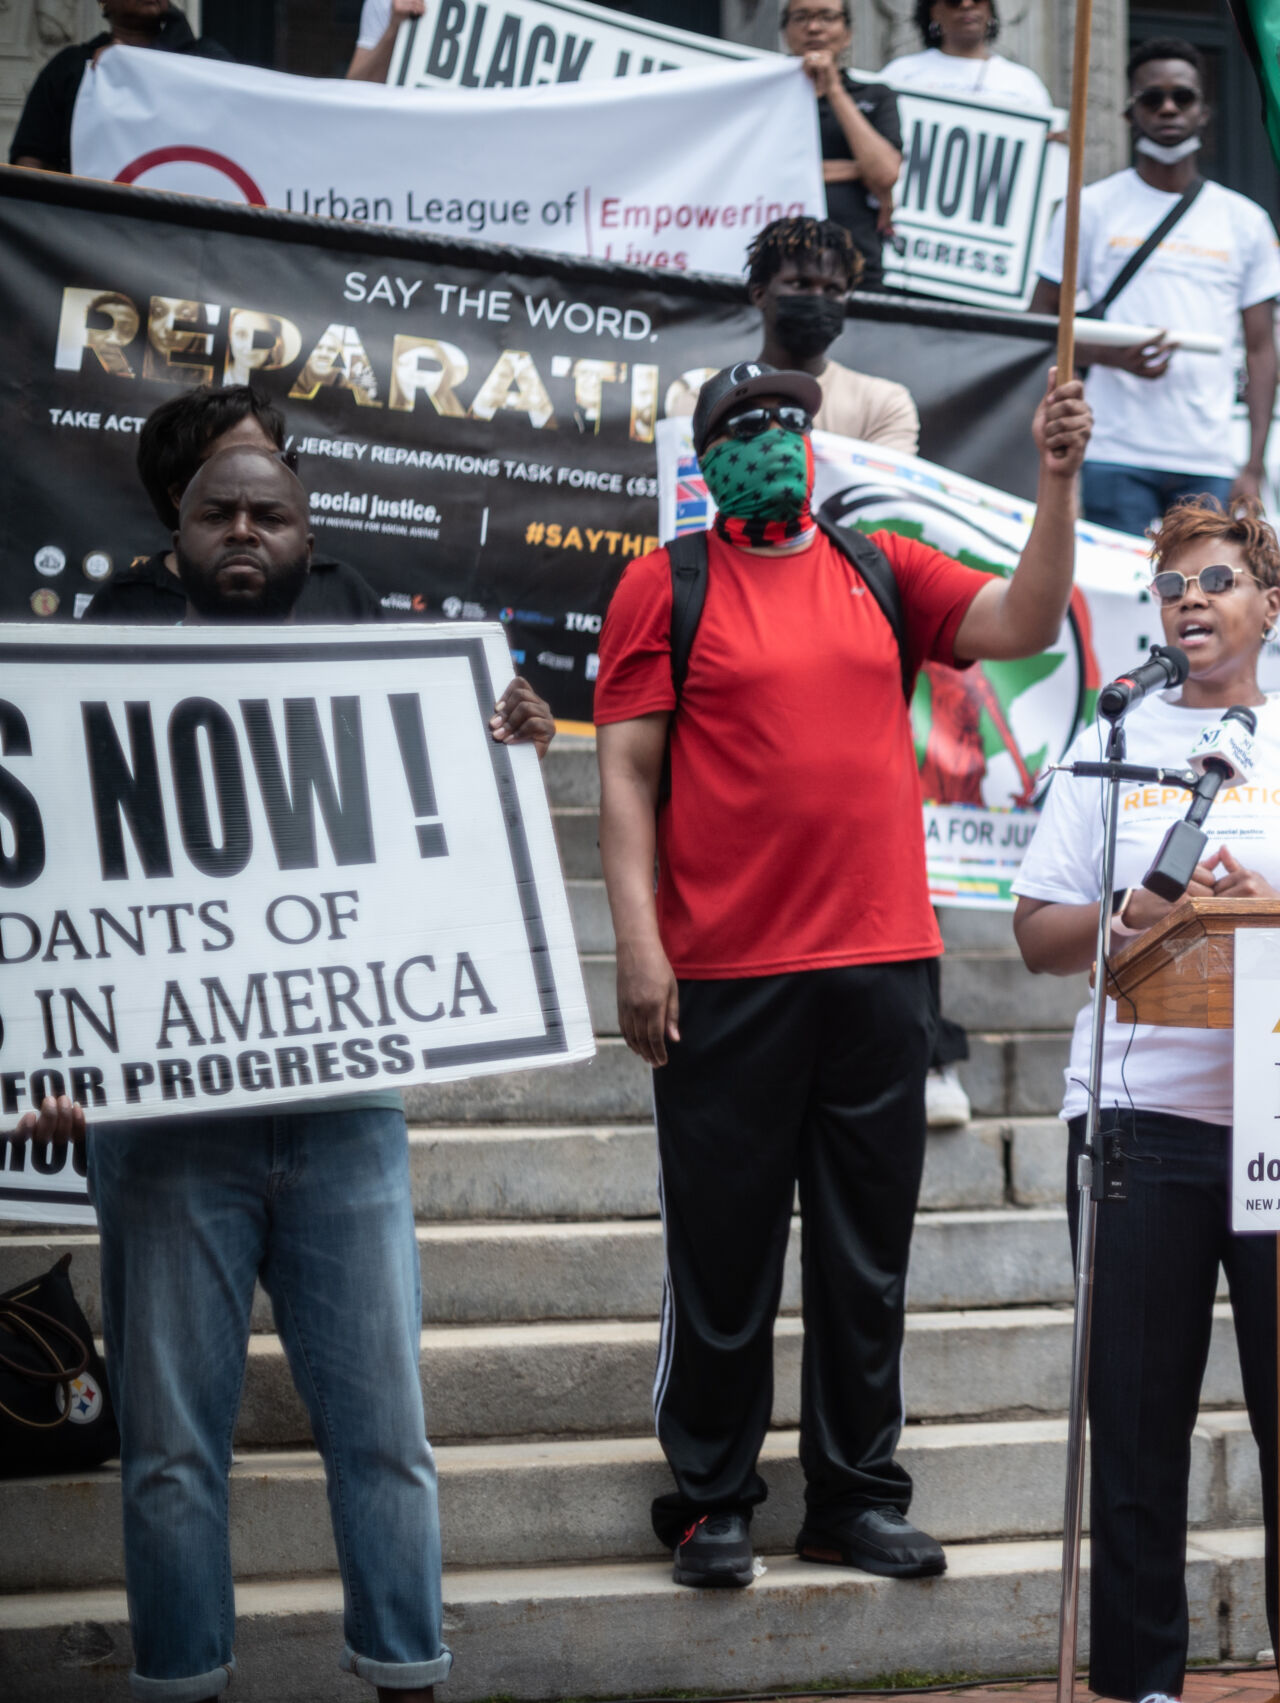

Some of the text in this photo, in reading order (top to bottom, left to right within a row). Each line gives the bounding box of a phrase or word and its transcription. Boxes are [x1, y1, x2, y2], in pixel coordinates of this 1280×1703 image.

[426, 0, 595, 88] BLACK
[902, 119, 1025, 228] NOW
[286, 188, 806, 235] Urban League of Empowering
[343, 271, 659, 343] SAY THE WORD.
[49, 408, 102, 428] TAKE
[296, 436, 368, 461] JERSEY
[371, 444, 500, 477] REPARATIONS
[503, 459, 554, 484] TASK
[557, 466, 624, 493] FORCE
[309, 491, 442, 524] social justice.
[79, 692, 450, 882] NOW!
[948, 819, 995, 846] FOR
[264, 890, 361, 946] OF
[35, 951, 498, 1060] IN AMERICA
[1, 1033, 417, 1116] FOR PROGRESS
[1245, 1198, 1274, 1211] NEW
